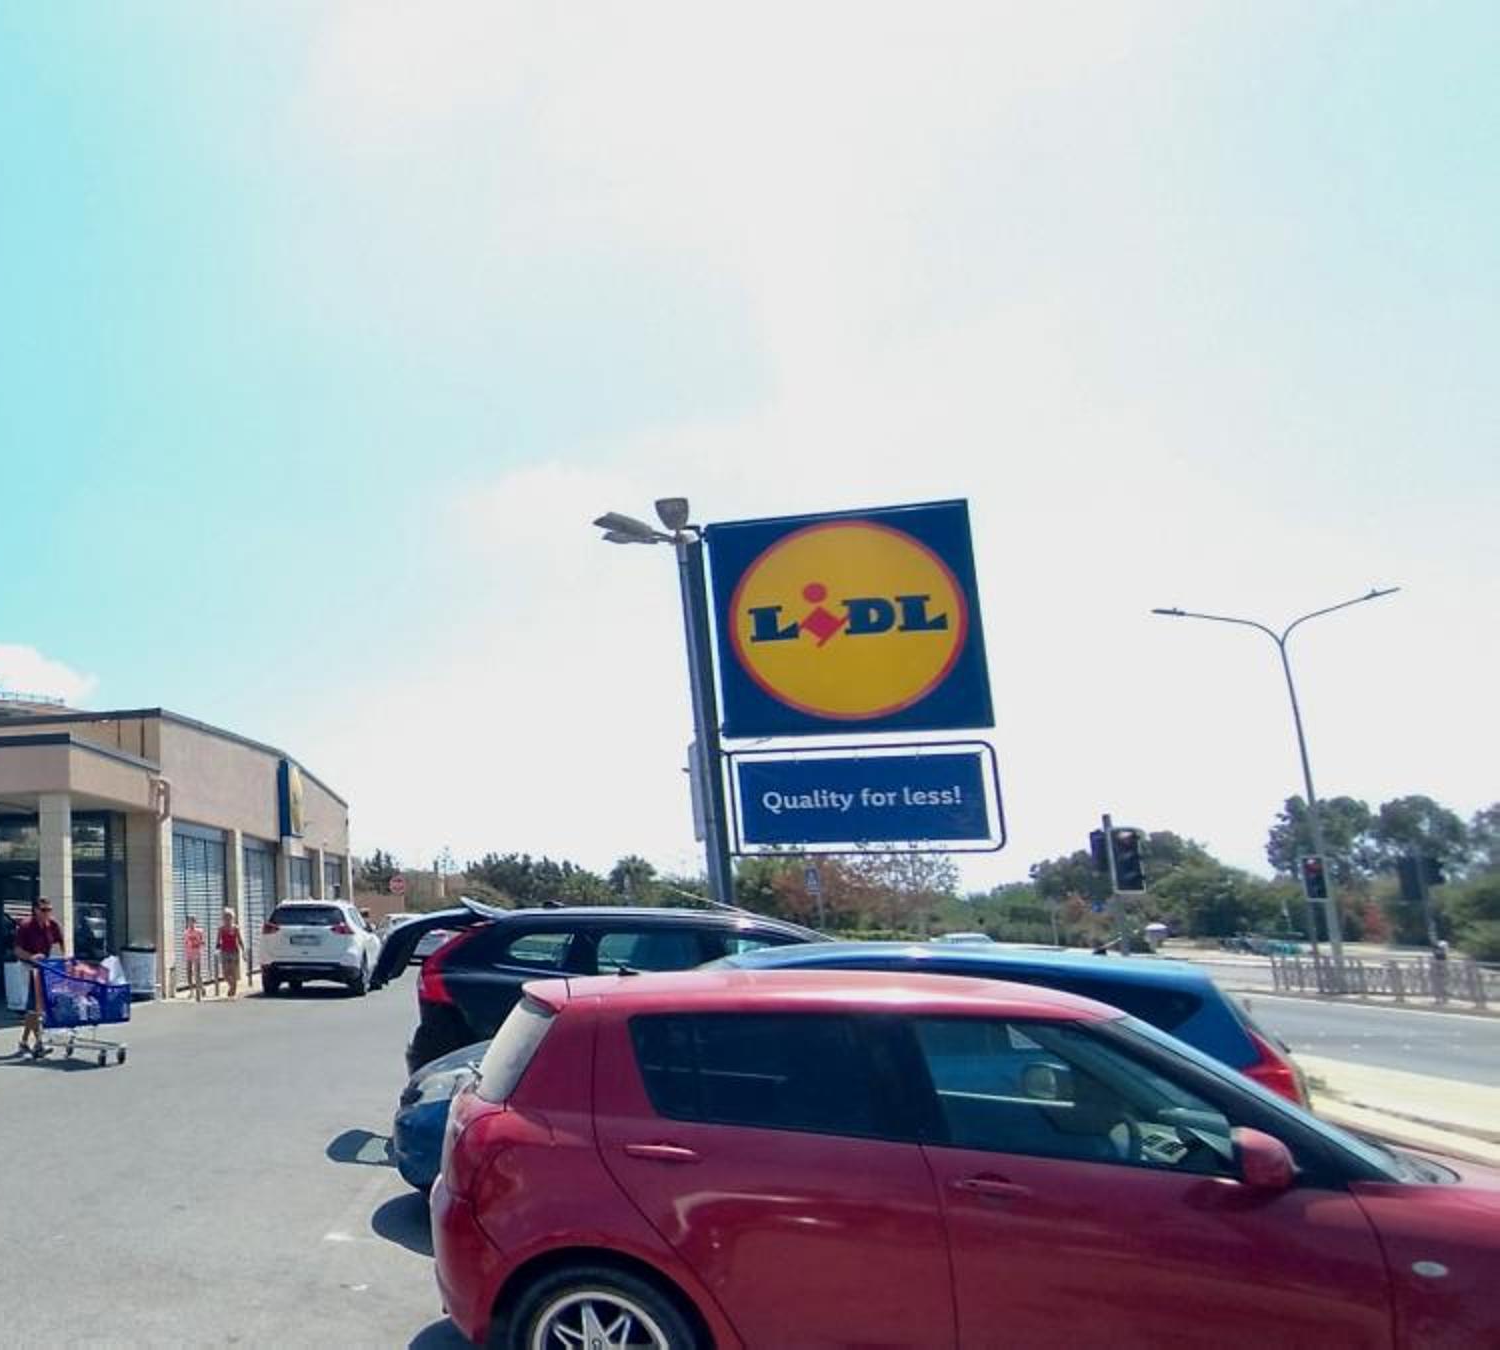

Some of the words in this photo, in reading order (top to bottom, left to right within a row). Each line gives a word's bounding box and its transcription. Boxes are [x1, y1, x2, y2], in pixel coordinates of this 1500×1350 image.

[762, 788, 853, 813] Quality
[860, 788, 896, 806] for
[903, 786, 962, 806] less!
